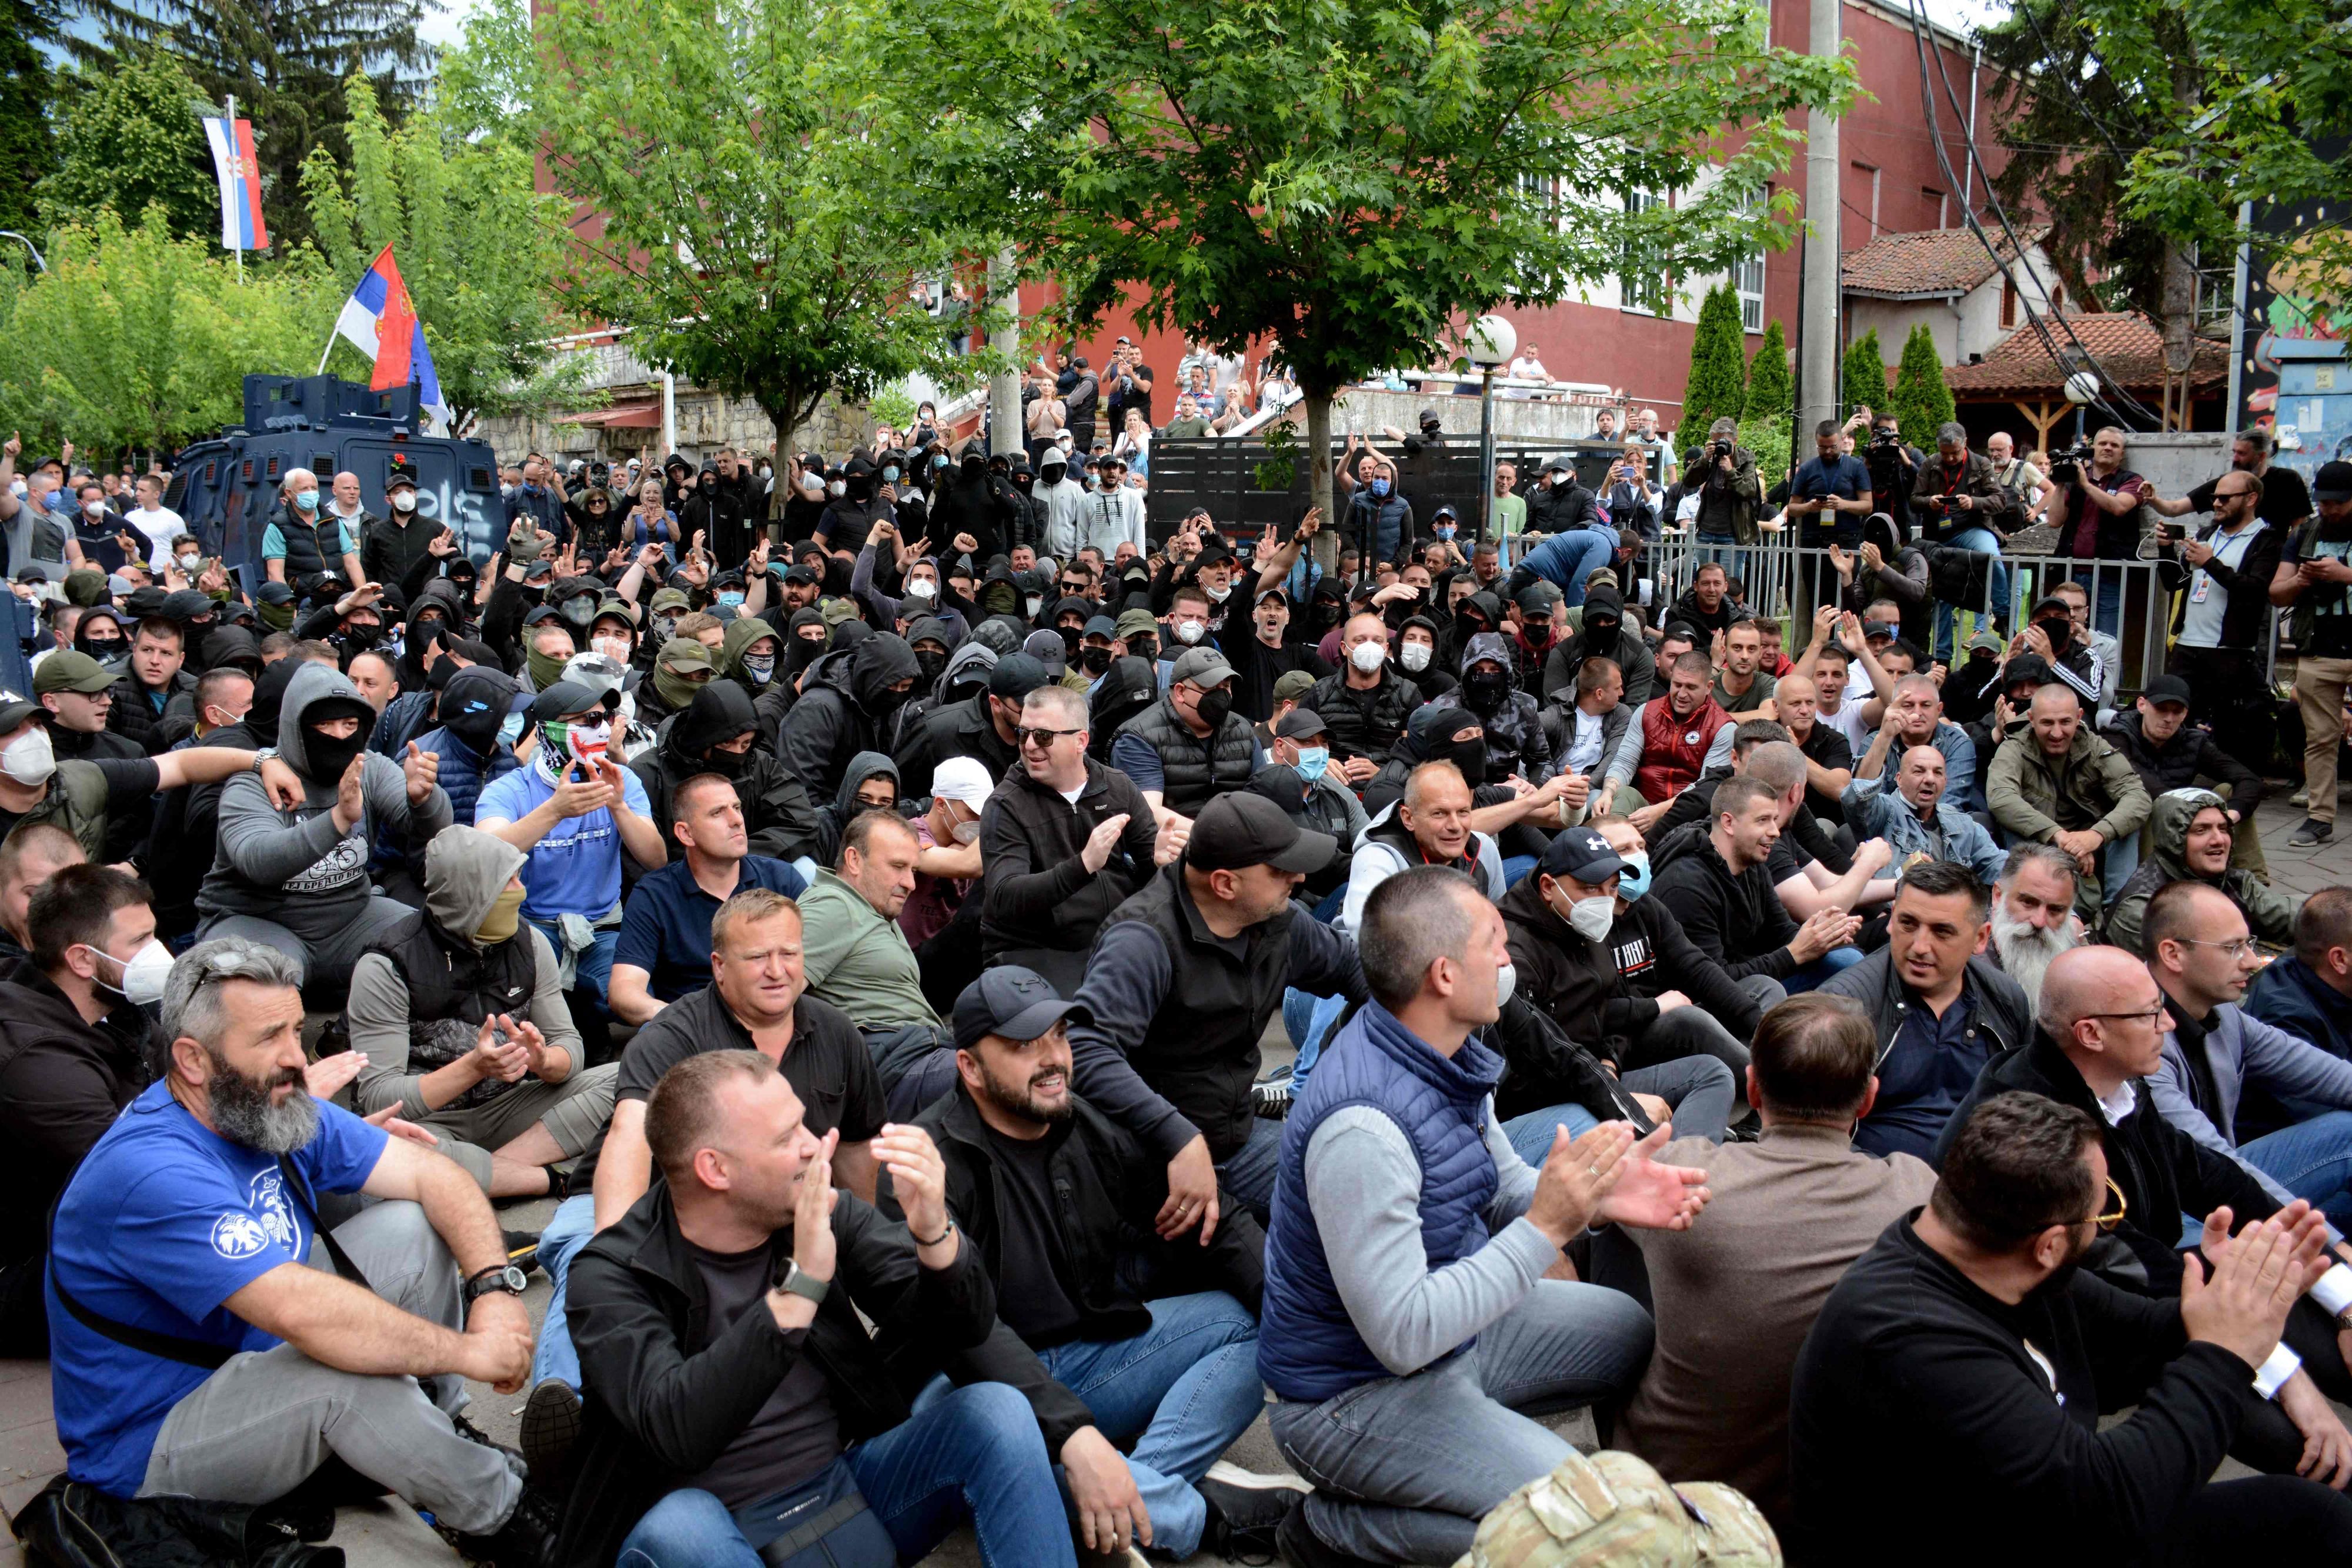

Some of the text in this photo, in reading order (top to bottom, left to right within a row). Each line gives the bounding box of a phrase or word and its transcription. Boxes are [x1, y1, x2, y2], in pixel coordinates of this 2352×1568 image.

[1331, 818, 1347, 831] NIK
[304, 881, 323, 890] БРЕ
[347, 867, 362, 878] БРЕ
